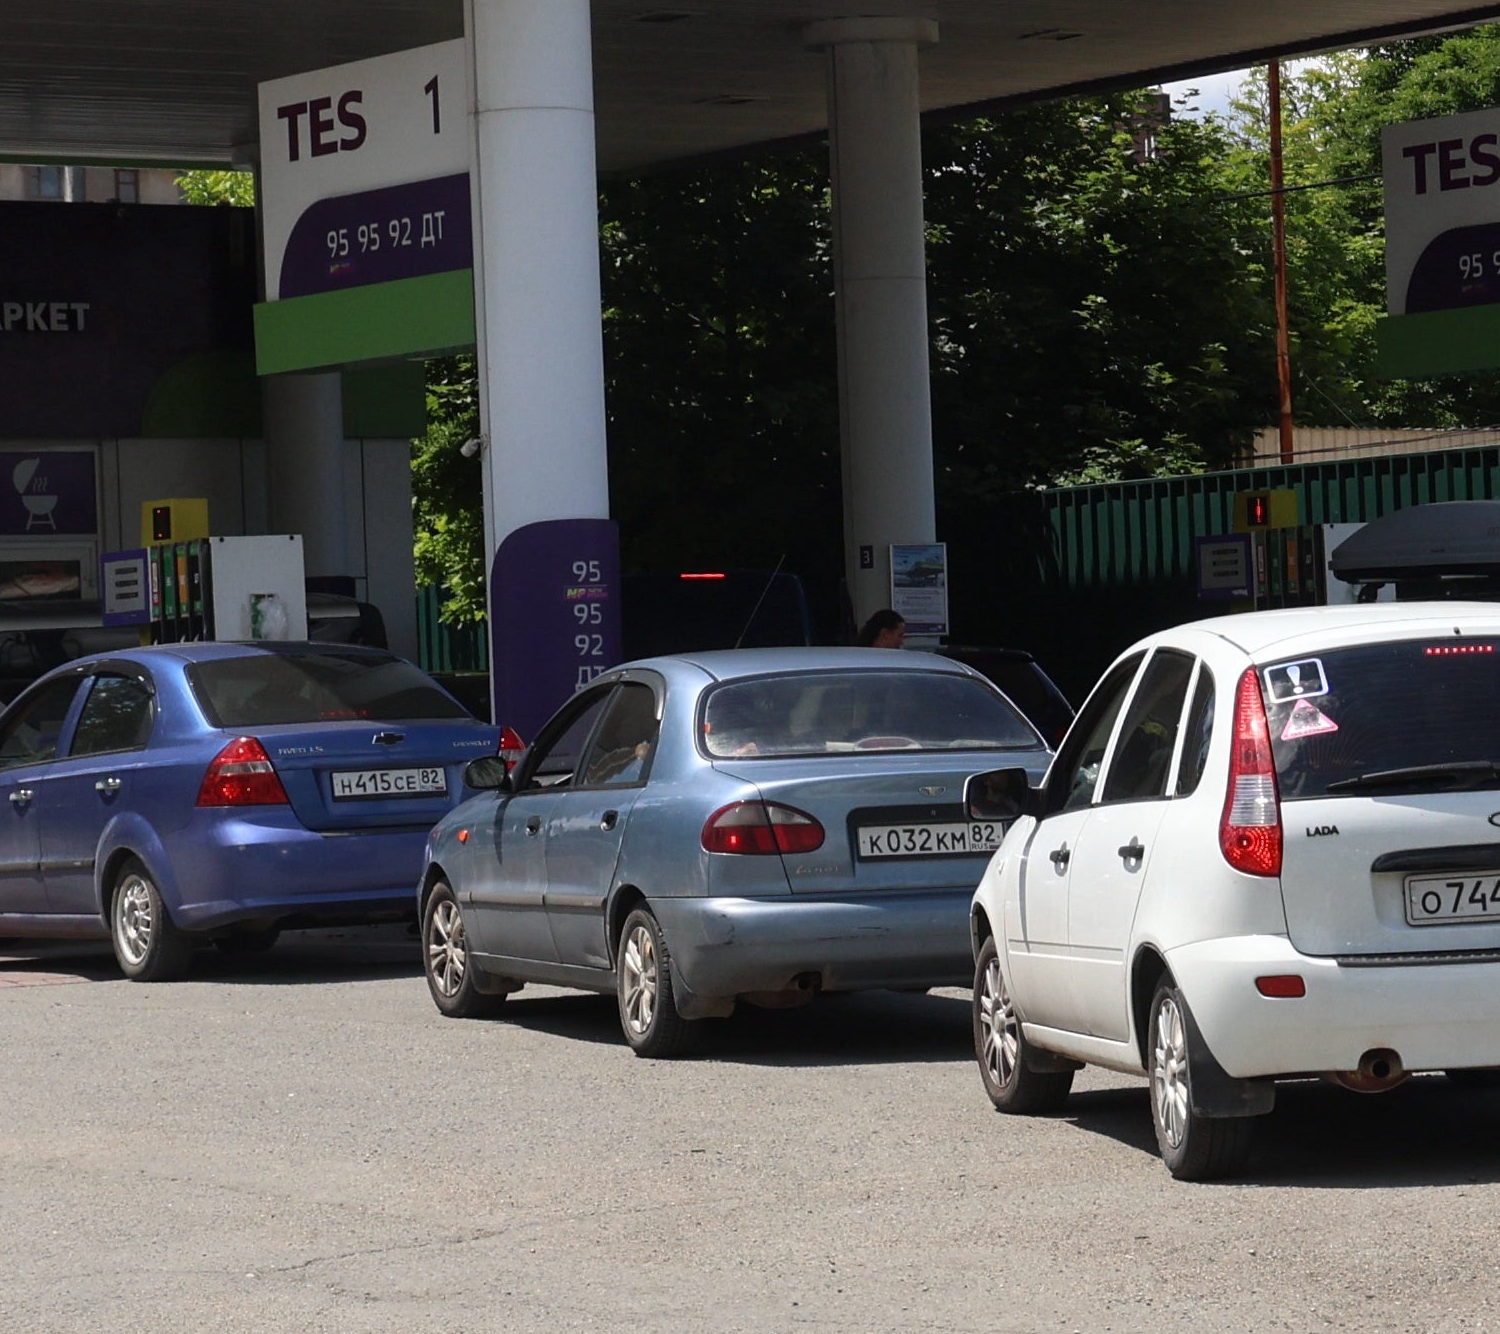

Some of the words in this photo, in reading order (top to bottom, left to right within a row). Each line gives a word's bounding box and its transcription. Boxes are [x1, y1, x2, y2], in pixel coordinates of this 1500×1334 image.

[277, 89, 367, 162] TES
[424, 74, 441, 135] 1
[327, 228, 349, 258] 95
[357, 222, 380, 253] 95
[388, 217, 412, 247] 92
[420, 210, 445, 249] ДТ
[1458, 253, 1483, 280] 95
[862, 550, 870, 564] 3
[572, 561, 601, 582] 95
[573, 603, 602, 624] 95
[574, 634, 603, 655] 92
[341, 773, 417, 794] Н415СЕ
[421, 769, 439, 784] 82
[869, 828, 966, 854] К032КМ
[971, 824, 996, 843] 82
[1306, 825, 1340, 837] LADA
[971, 842, 989, 850] RUS
